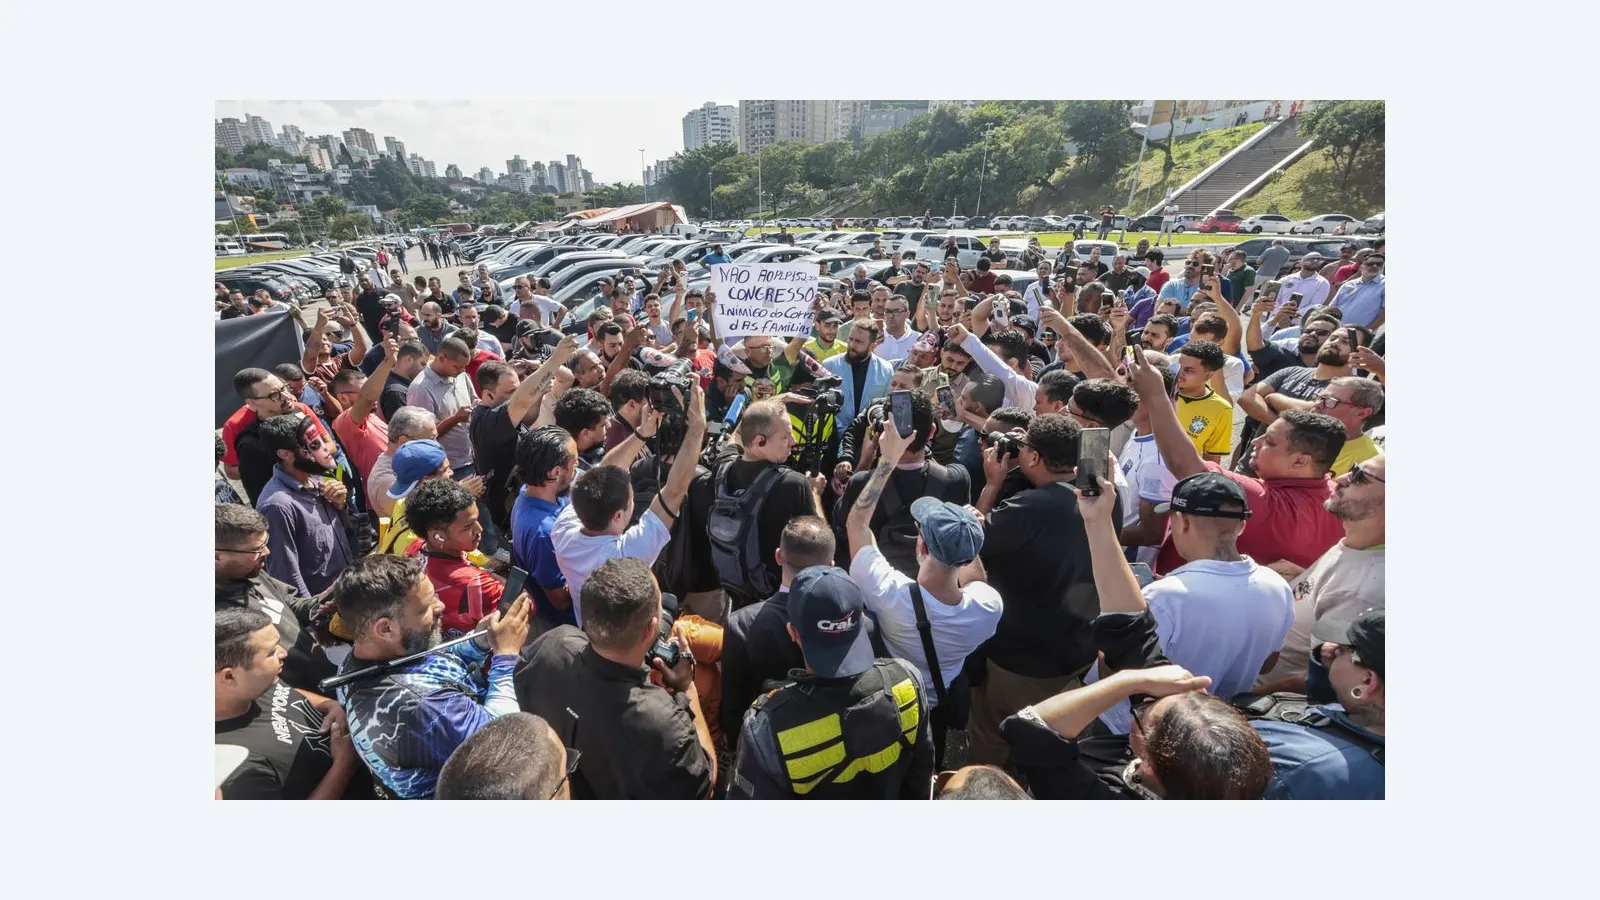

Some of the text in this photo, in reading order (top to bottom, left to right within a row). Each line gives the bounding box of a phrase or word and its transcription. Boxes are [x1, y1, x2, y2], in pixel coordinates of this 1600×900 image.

[728, 286, 815, 303] CONGRESSO
[271, 682, 293, 745] NEW YORK
